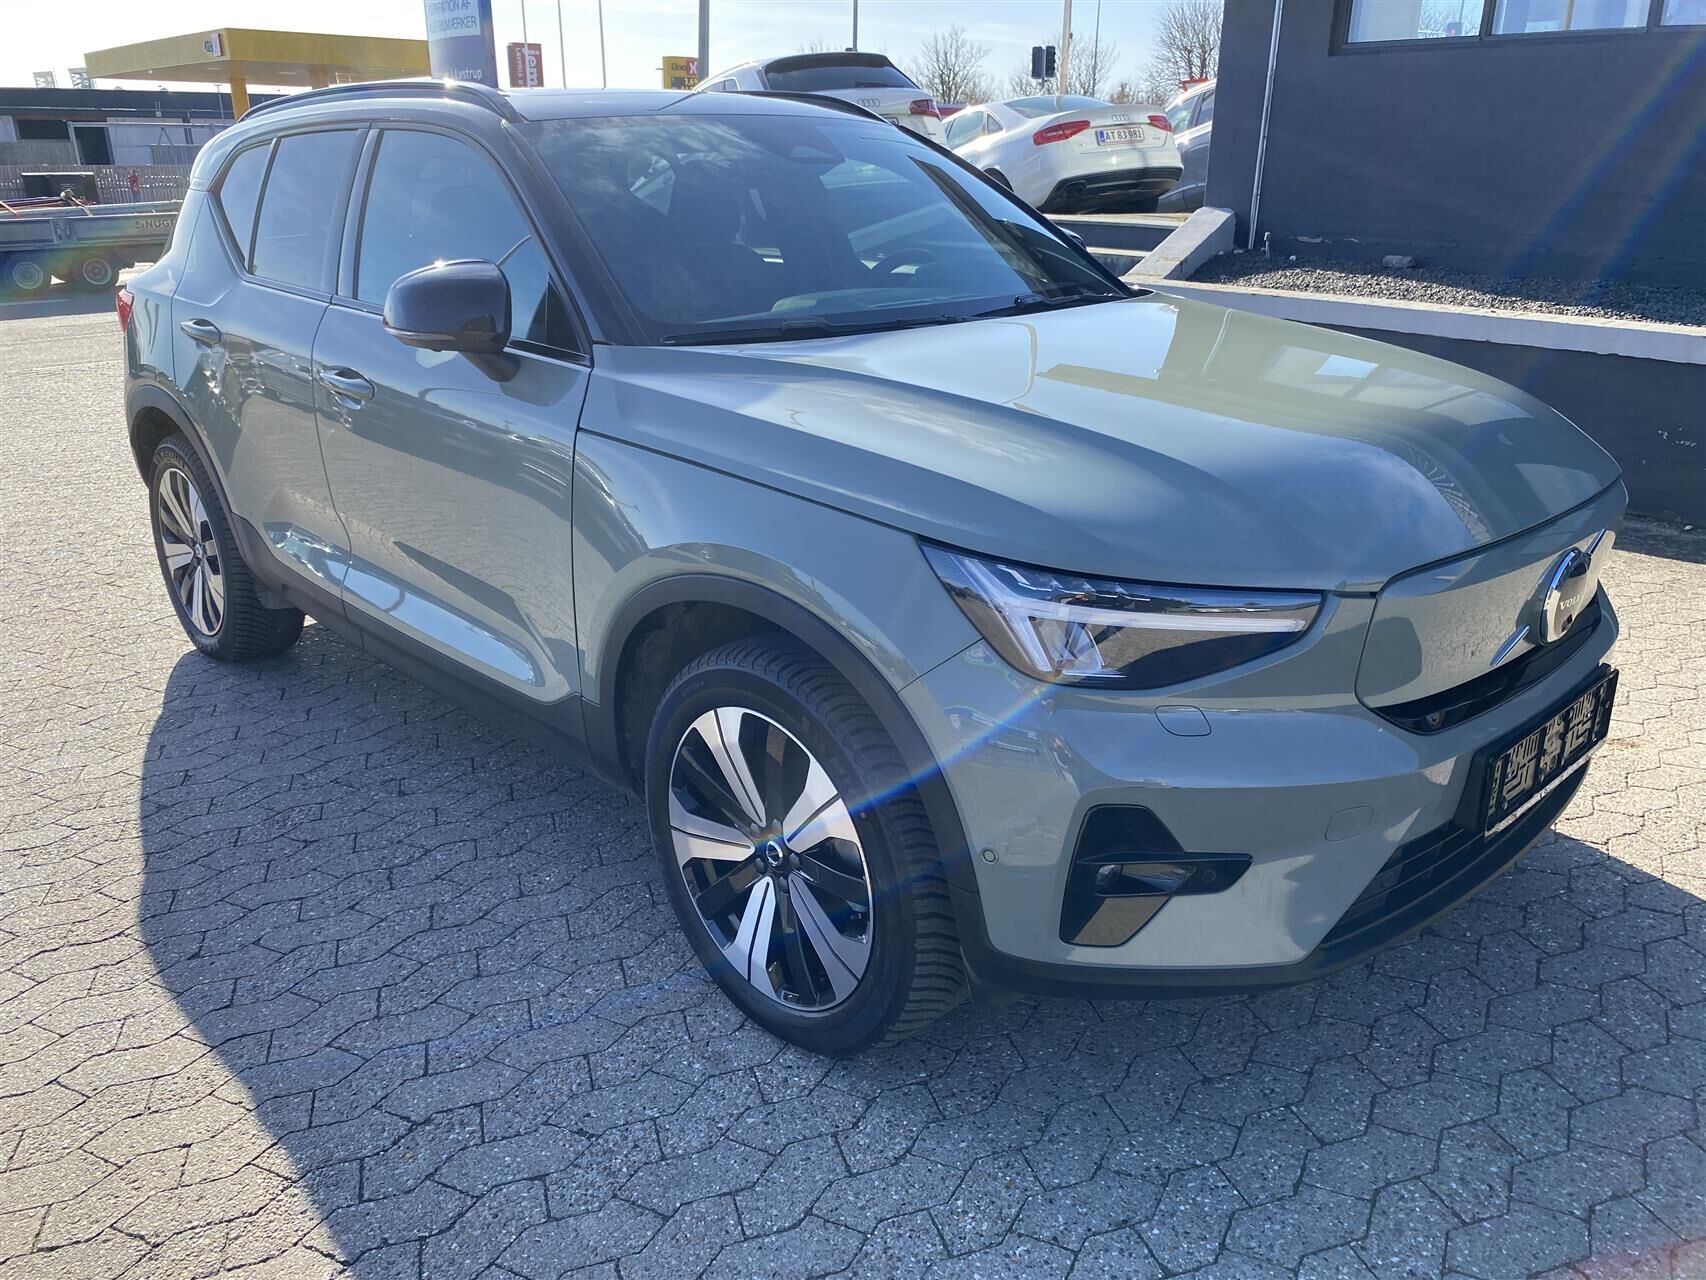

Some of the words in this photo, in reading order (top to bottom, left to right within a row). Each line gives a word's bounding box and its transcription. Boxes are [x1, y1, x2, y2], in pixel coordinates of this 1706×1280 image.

[454, 66, 483, 81] Lystrup
[1105, 131, 1116, 140] AT
[1117, 130, 1127, 140] 83
[1128, 129, 1142, 139] 981
